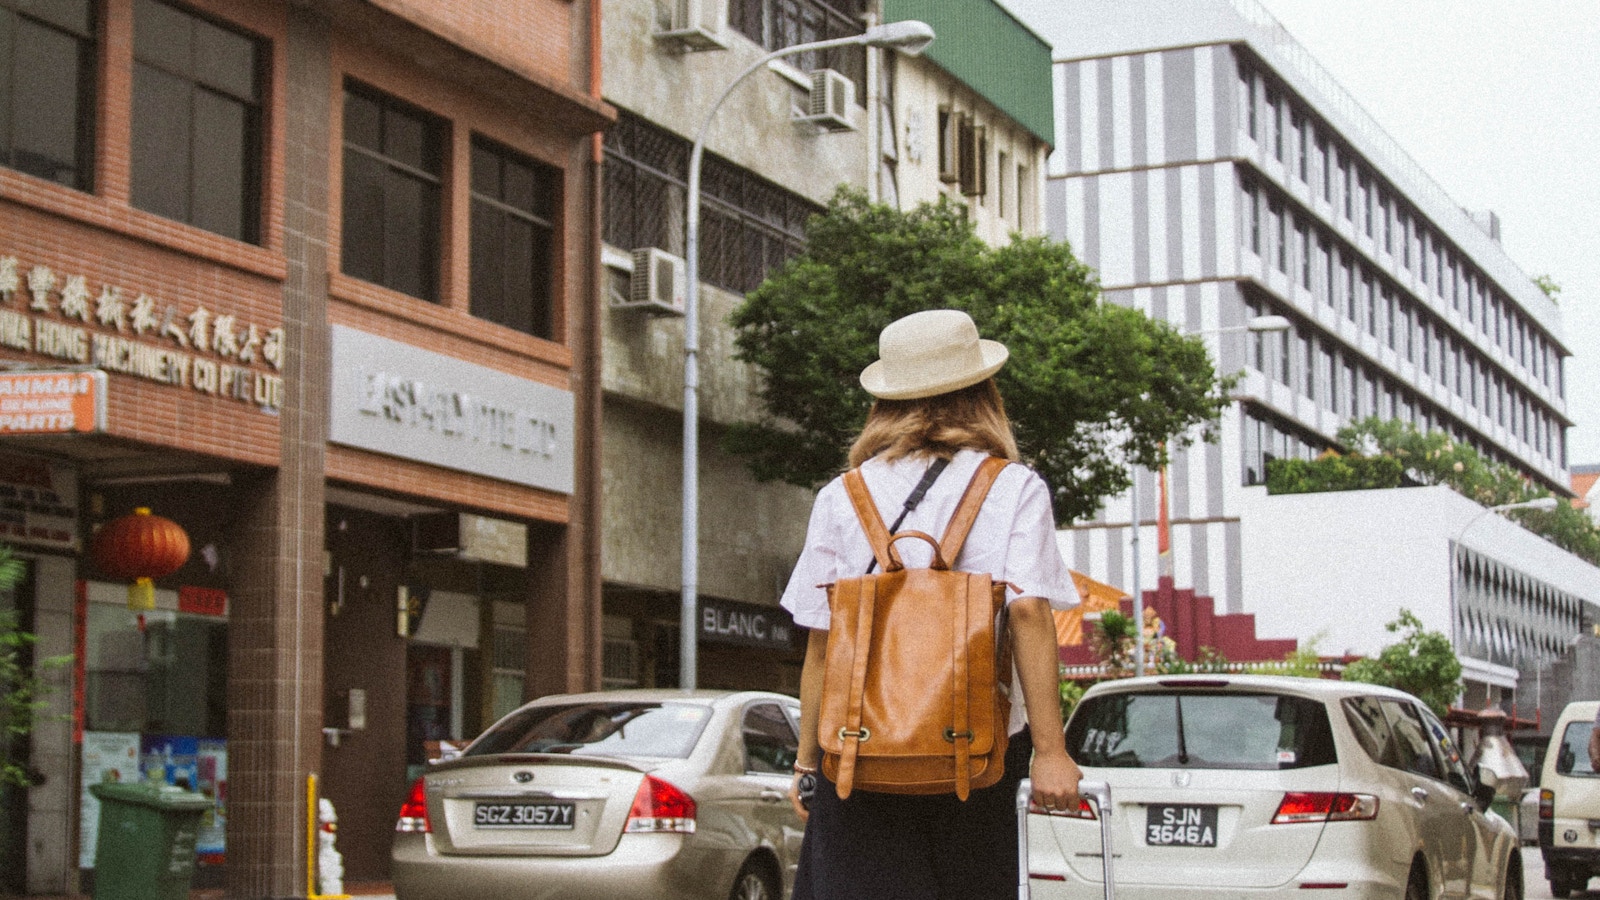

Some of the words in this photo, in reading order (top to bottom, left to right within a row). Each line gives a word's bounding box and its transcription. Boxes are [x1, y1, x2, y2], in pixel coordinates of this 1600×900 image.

[35, 319, 88, 361] HONG
[92, 333, 190, 387] MACHINERY
[193, 358, 217, 394] CO
[220, 364, 251, 400] PTE
[703, 607, 766, 640] BLANC
[1162, 807, 1202, 826] SJN
[1148, 824, 1214, 846] 3646A
